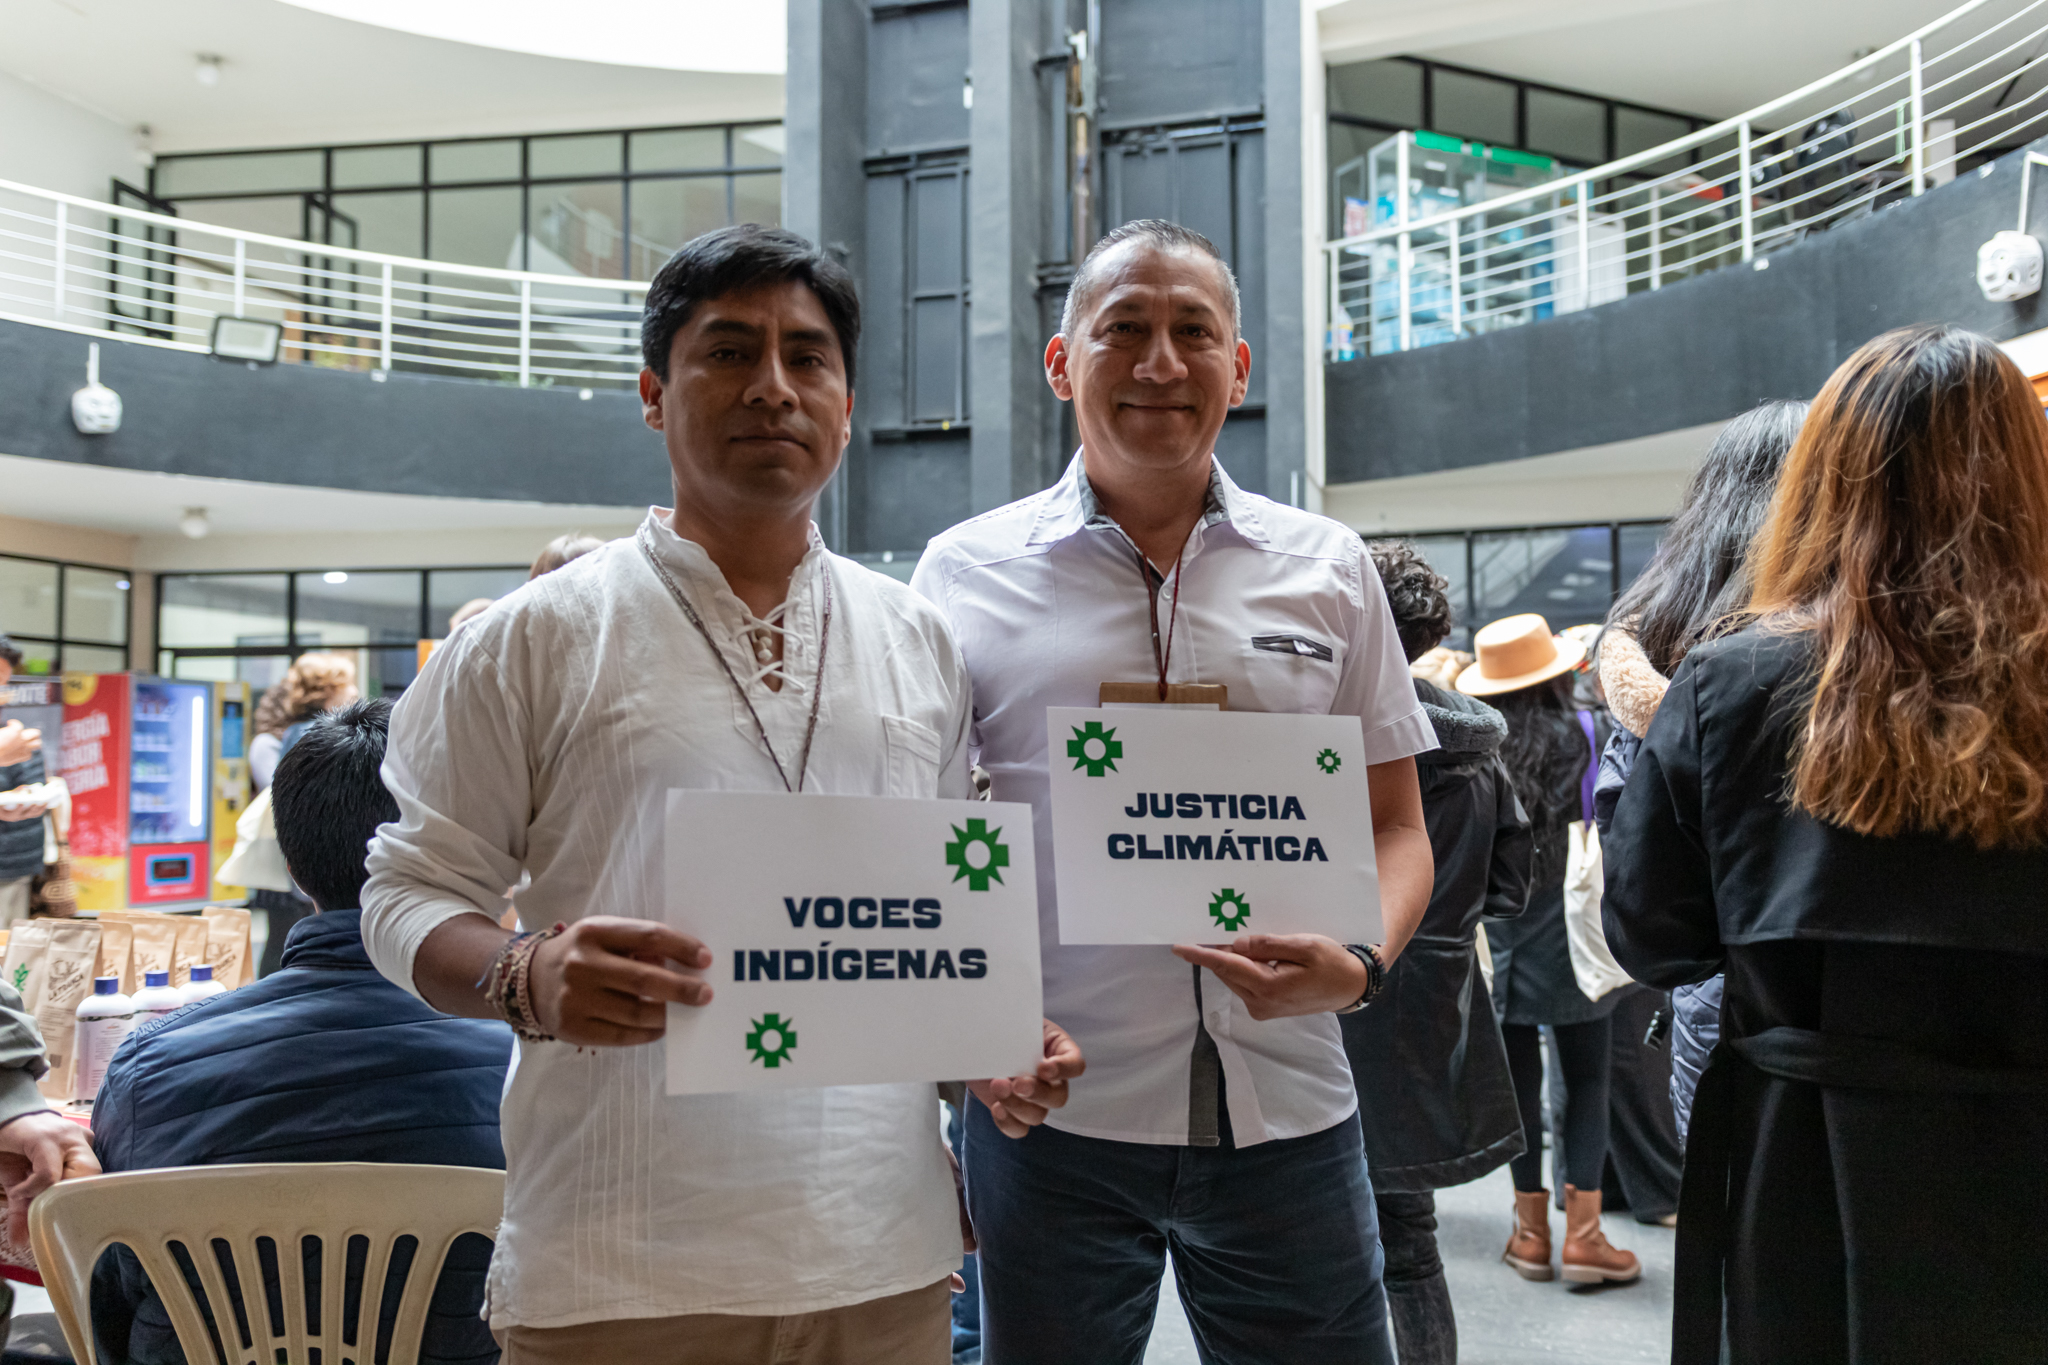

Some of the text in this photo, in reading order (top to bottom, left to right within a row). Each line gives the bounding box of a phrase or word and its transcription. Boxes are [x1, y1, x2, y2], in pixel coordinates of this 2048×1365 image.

[1124, 792, 1307, 821] JUSTICIA
[1107, 828, 1329, 862] CLIMÁTICA
[783, 896, 942, 930] VOCES
[733, 940, 988, 983] INDÍGENAS
